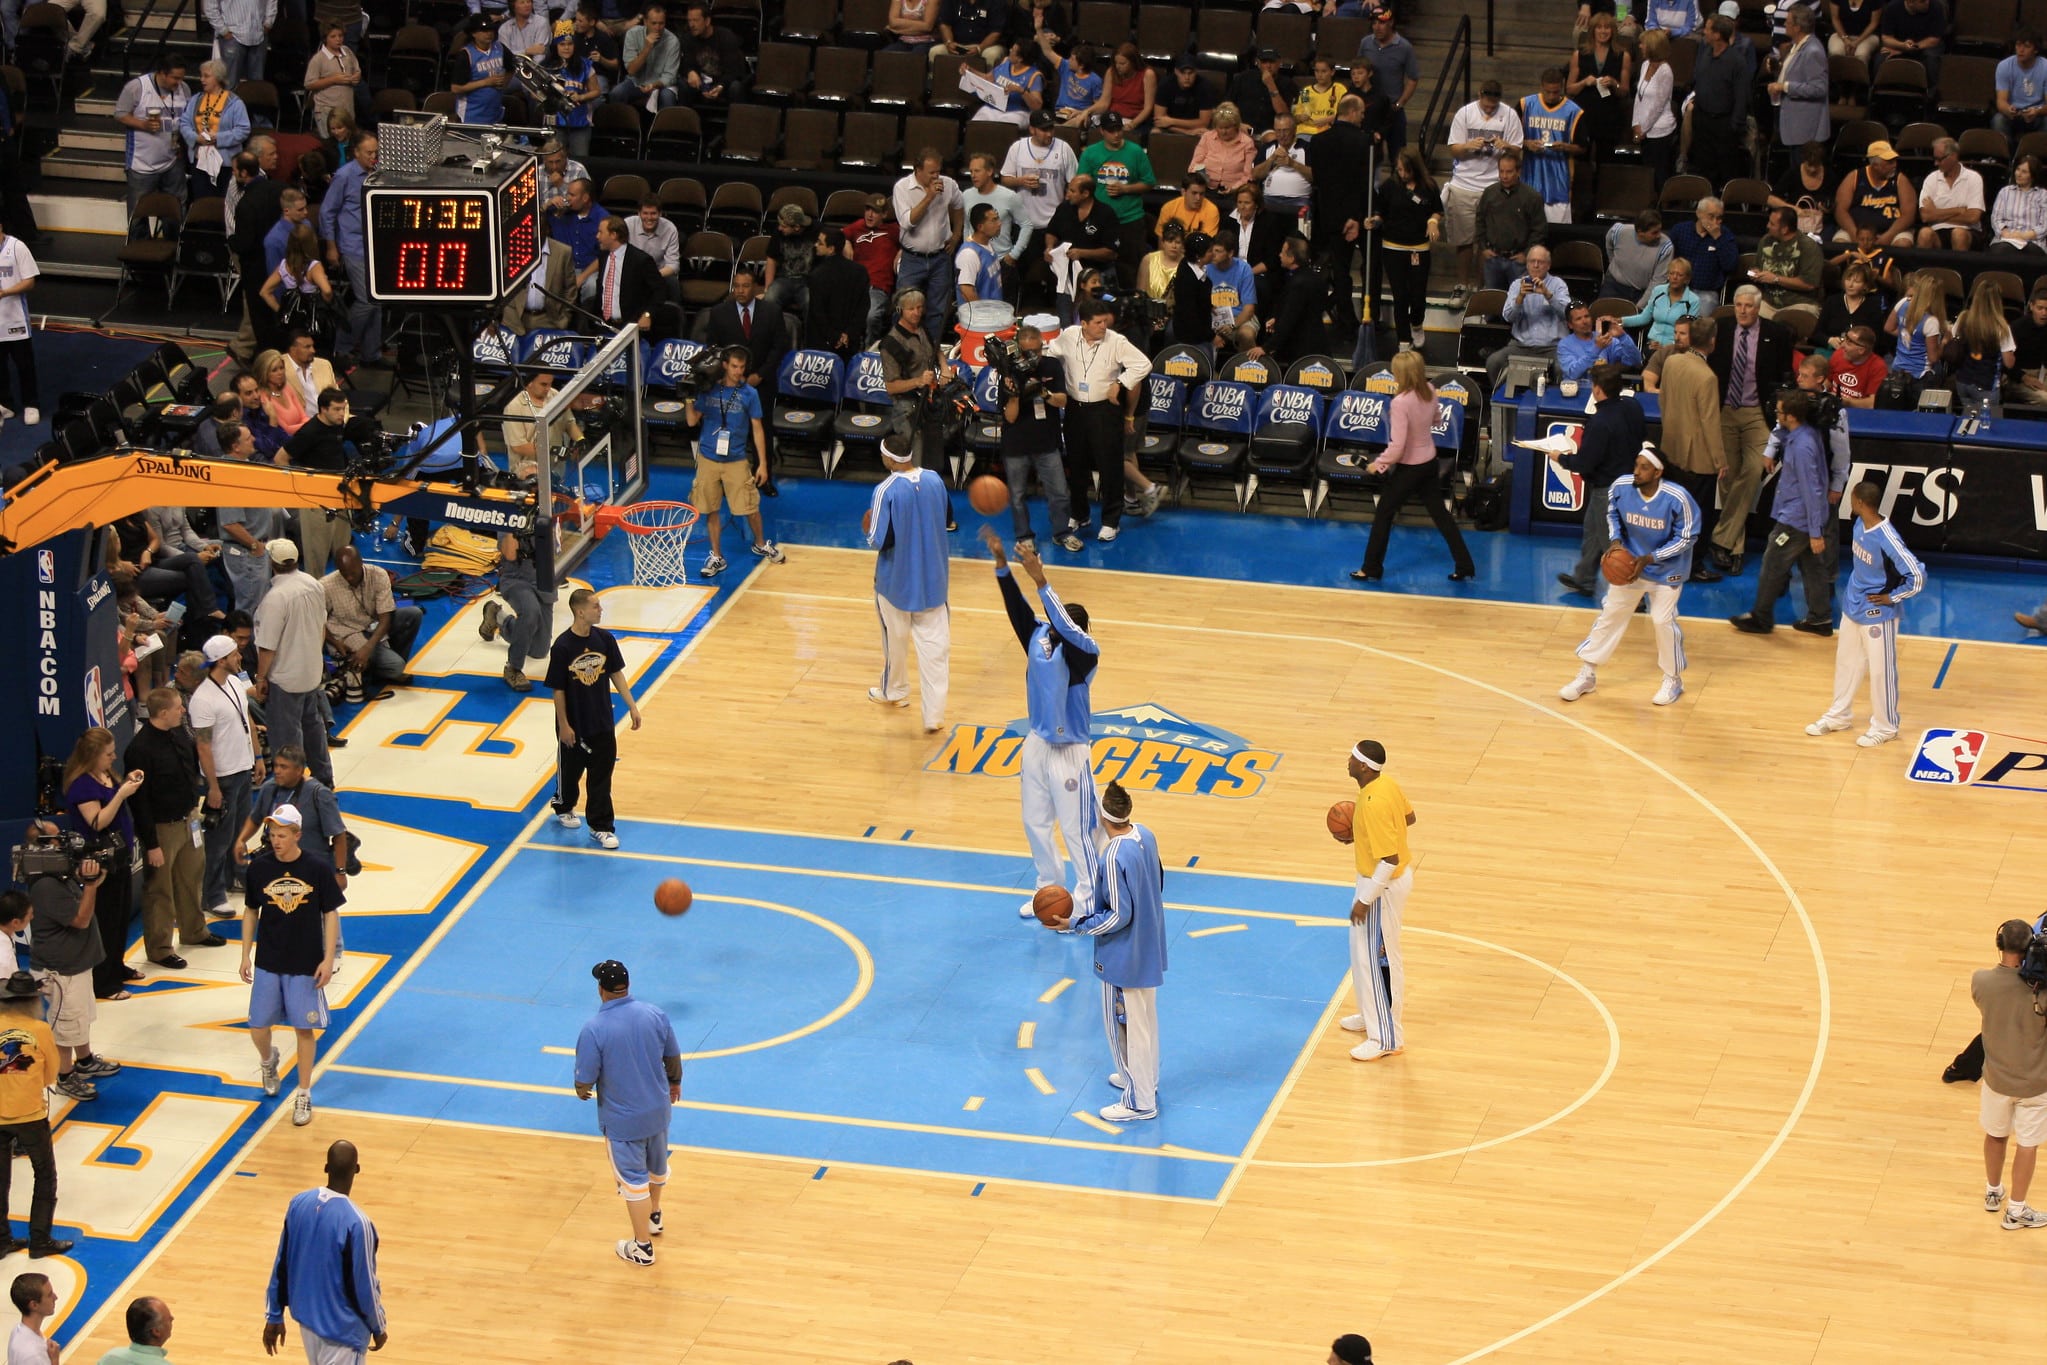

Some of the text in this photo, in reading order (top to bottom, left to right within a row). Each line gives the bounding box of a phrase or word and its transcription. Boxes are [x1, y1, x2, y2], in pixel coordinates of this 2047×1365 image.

[1528, 116, 1566, 132] DENVER
[1542, 130, 1551, 143] 3
[404, 199, 482, 229] 7:35
[397, 241, 468, 289] 00
[802, 356, 836, 374] NBA
[790, 370, 831, 387] Cares
[1213, 385, 1247, 406] NBA
[1281, 391, 1314, 410] NBA
[1202, 402, 1243, 421] Cares
[1270, 406, 1311, 425] Cares
[1350, 396, 1384, 416] NBA
[1339, 412, 1380, 431] Cares
[136, 457, 211, 482] SPALDING
[1548, 491, 1572, 506] NBA
[1626, 512, 1665, 530] DENVER
[86, 580, 112, 613] SPALDING
[38, 590, 61, 716] NBA.COM
[1102, 724, 1231, 753] NVER
[924, 722, 1284, 800] NUGETS
[1914, 769, 1952, 781] NBA
